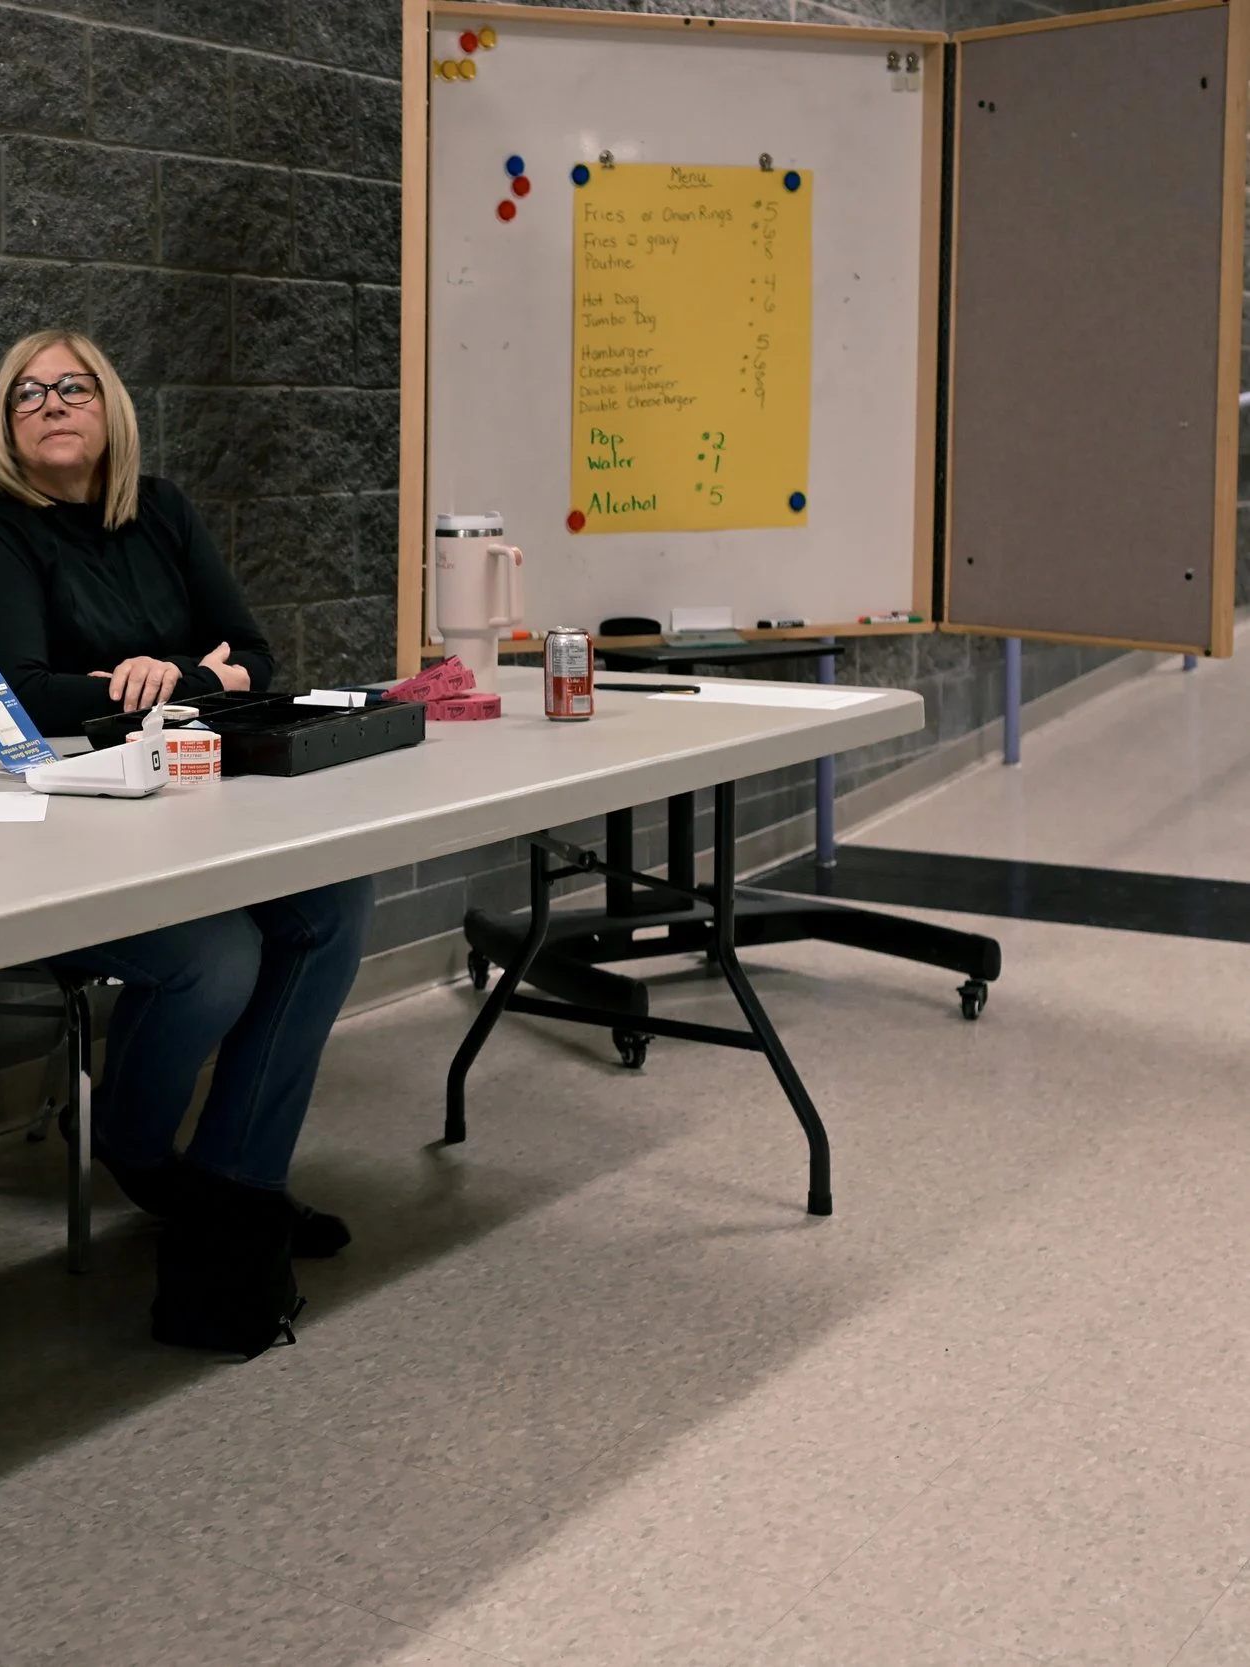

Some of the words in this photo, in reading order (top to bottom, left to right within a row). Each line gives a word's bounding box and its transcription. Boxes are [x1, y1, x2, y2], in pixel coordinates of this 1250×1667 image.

[670, 167, 707, 185] Menu
[584, 202, 626, 223] Fries
[698, 204, 733, 228] Rings
[583, 232, 617, 249] Fries
[584, 251, 635, 270] Poutine
[582, 292, 603, 308] Hot
[614, 292, 639, 312] Dog
[581, 311, 626, 328] Jumbo
[632, 310, 657, 334] Dog
[581, 344, 654, 366] Hamburger
[591, 428, 624, 451] Pop
[587, 491, 656, 516] Alcohol
